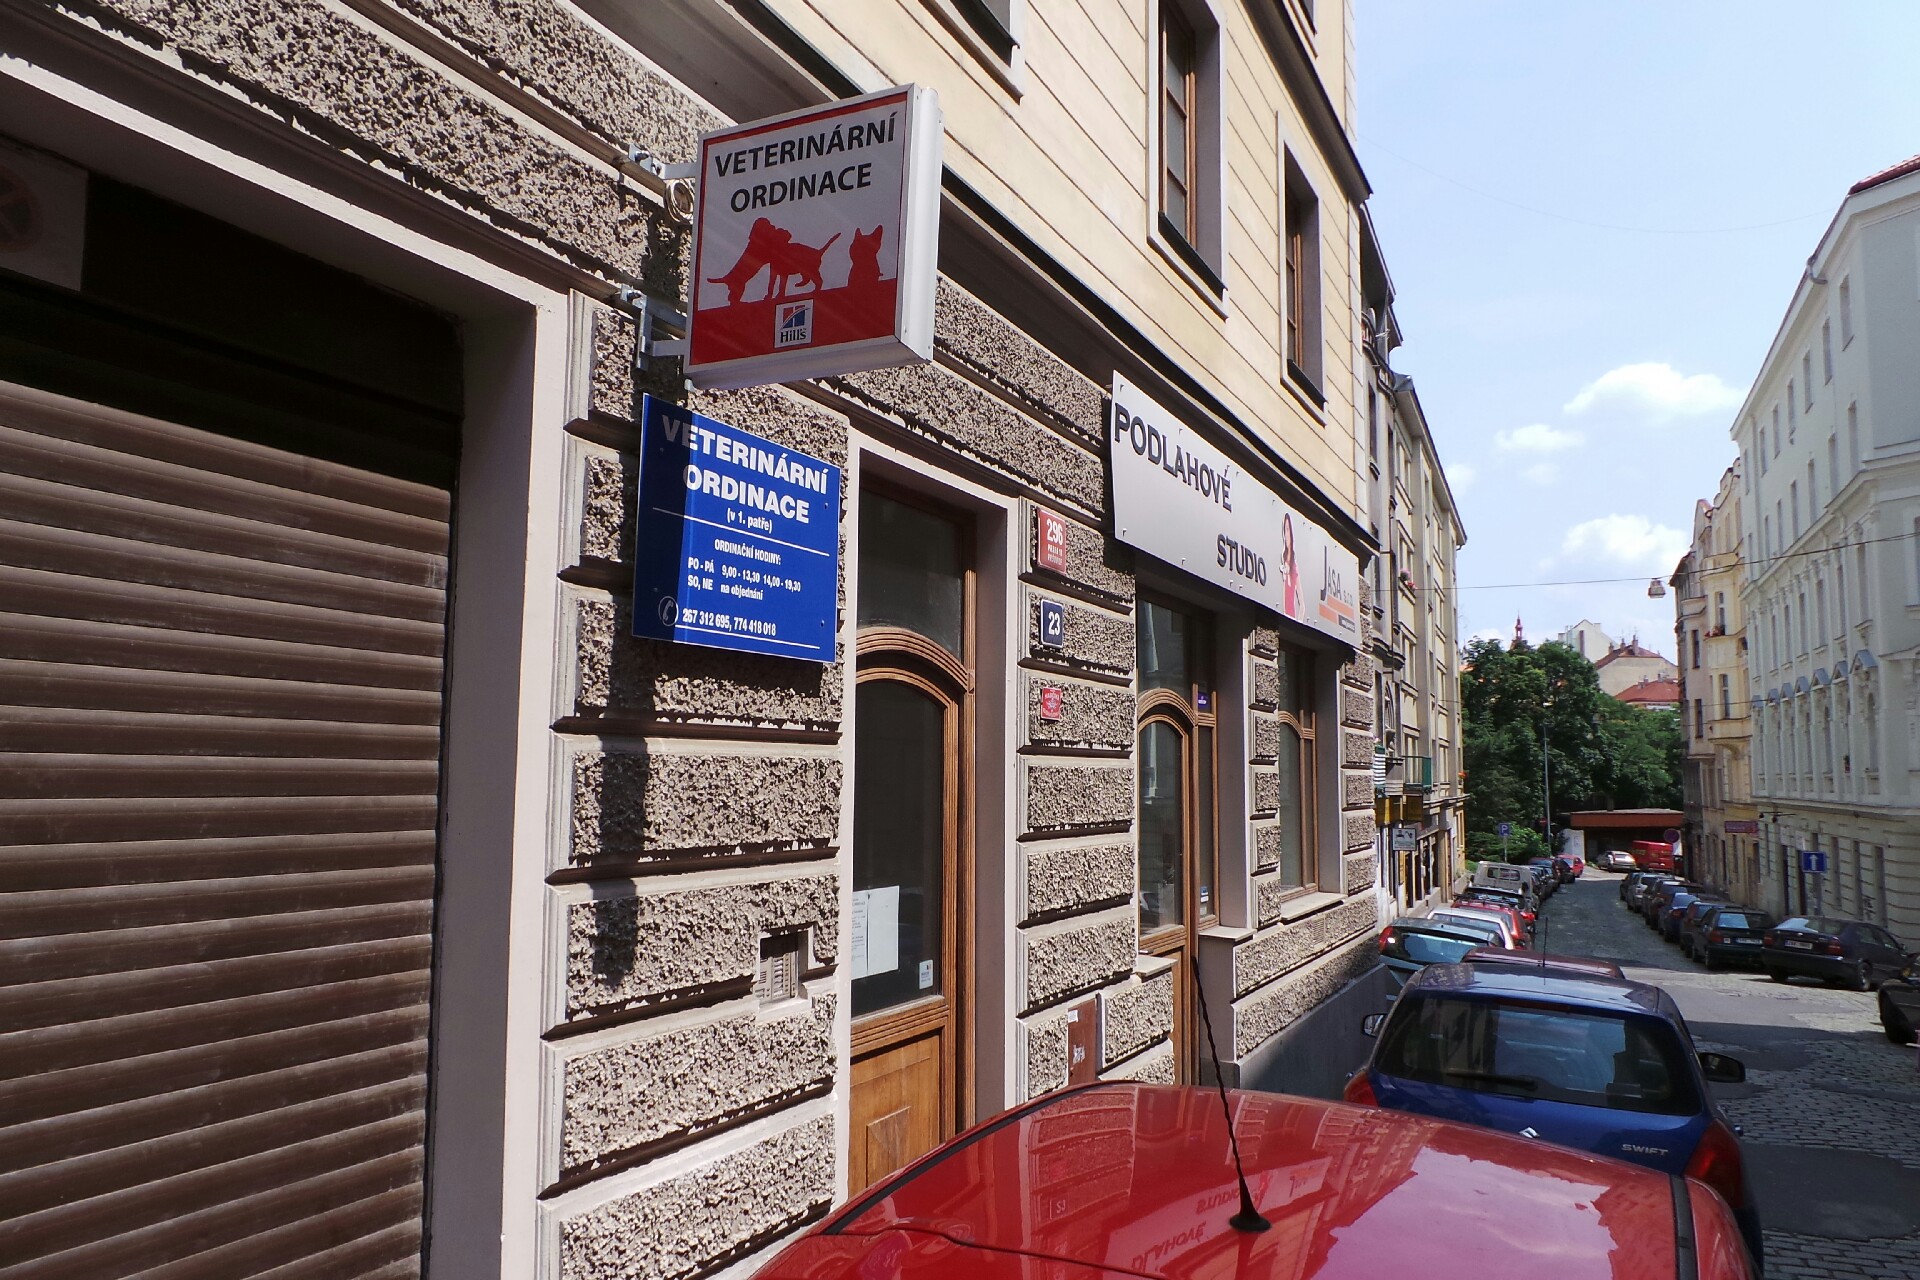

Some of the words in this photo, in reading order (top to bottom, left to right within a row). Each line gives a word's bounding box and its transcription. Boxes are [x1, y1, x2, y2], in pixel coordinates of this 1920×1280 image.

[715, 112, 898, 177] VETERINÁRNÍ
[730, 163, 872, 213] ORDINACE
[662, 415, 829, 494] VETERINÁRNÍ
[1114, 403, 1232, 512] PODLAHOVÉ
[683, 464, 809, 523] ORDINACE
[738, 511, 746, 524] 1.
[747, 516, 773, 534] patře)
[1046, 518, 1063, 545] 296
[714, 539, 754, 558] ORDINAČNÍ
[755, 549, 781, 565] HODINY:
[1217, 533, 1267, 587] STUDIO
[688, 557, 699, 570] PO
[705, 559, 714, 573] PÁ
[722, 565, 737, 579] 9,00
[742, 569, 760, 584] 13,30
[763, 574, 780, 588] 14,00
[785, 579, 801, 592] 19,30
[688, 575, 701, 590] SO,
[702, 578, 713, 590] NE
[721, 584, 730, 594] na
[731, 585, 764, 600] objednání
[682, 608, 698, 623] 267
[699, 611, 714, 626] 312
[715, 614, 732, 632] 695,
[733, 617, 747, 631] 774
[748, 619, 762, 633] 418
[763, 622, 776, 636] 018
[1048, 612, 1061, 636] 23
[1621, 1143, 1669, 1156] SWIFT
